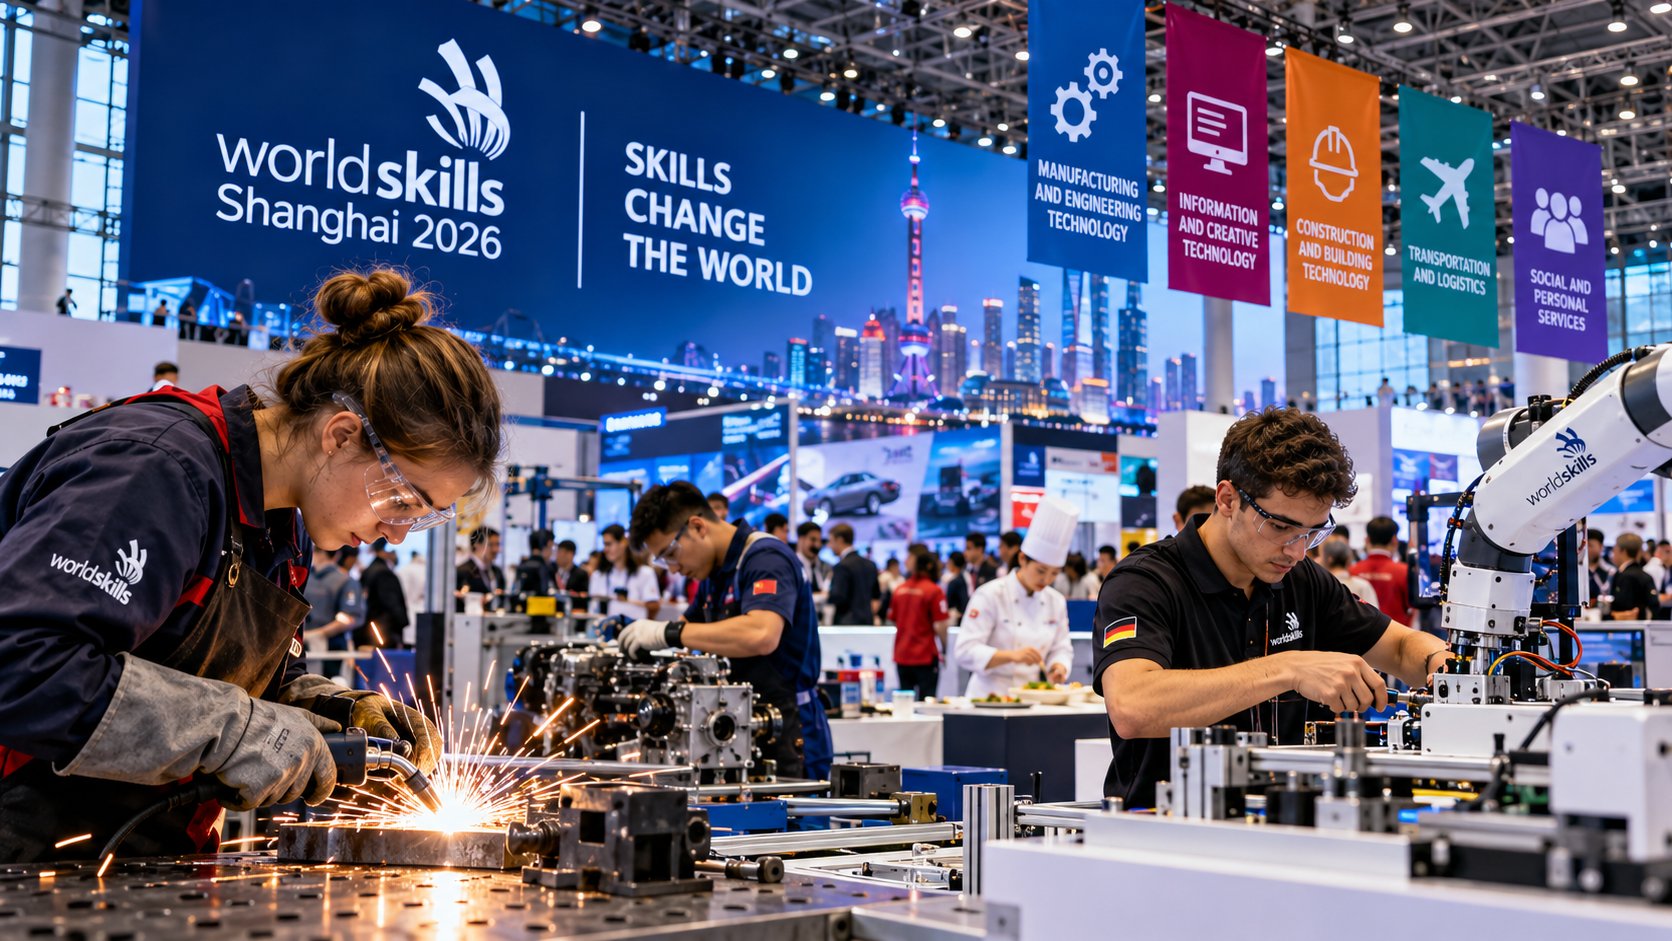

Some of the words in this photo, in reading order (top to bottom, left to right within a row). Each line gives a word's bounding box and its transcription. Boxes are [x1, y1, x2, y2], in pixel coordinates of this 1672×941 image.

[216, 133, 504, 217] worldskills
[625, 141, 732, 195] SKILLS
[1038, 159, 1138, 198] MANUFACTURING
[624, 188, 765, 247] CHANGE
[1035, 183, 1062, 204] AND
[1065, 189, 1141, 222] ENGINEERING
[1179, 192, 1258, 226] INFORMATION
[216, 183, 399, 245] Shanghai
[412, 214, 501, 260] 2026
[1048, 209, 1128, 242] TECHNOLOGY
[1179, 216, 1204, 237] AND
[1207, 222, 1258, 248] CREATIVE
[1296, 218, 1374, 251] CONSTRUCTION
[623, 233, 687, 277] THE
[699, 246, 813, 297] WORLD
[1183, 239, 1256, 270] TECHNOLOGY
[1299, 241, 1322, 259] AND
[1324, 246, 1373, 271] BUILDING
[1408, 245, 1490, 277] TRANSPORTATION
[1302, 262, 1370, 291] TECHNOLOGY
[1413, 267, 1435, 285] AND
[1438, 272, 1486, 296] LOGISTICS
[1530, 269, 1567, 291] SOCIAL
[1569, 277, 1591, 295] AND
[1534, 288, 1589, 313] PERSONAL
[1538, 310, 1586, 331] SERVICES
[1526, 454, 1597, 506] worldskills
[50, 553, 132, 605] worldskills
